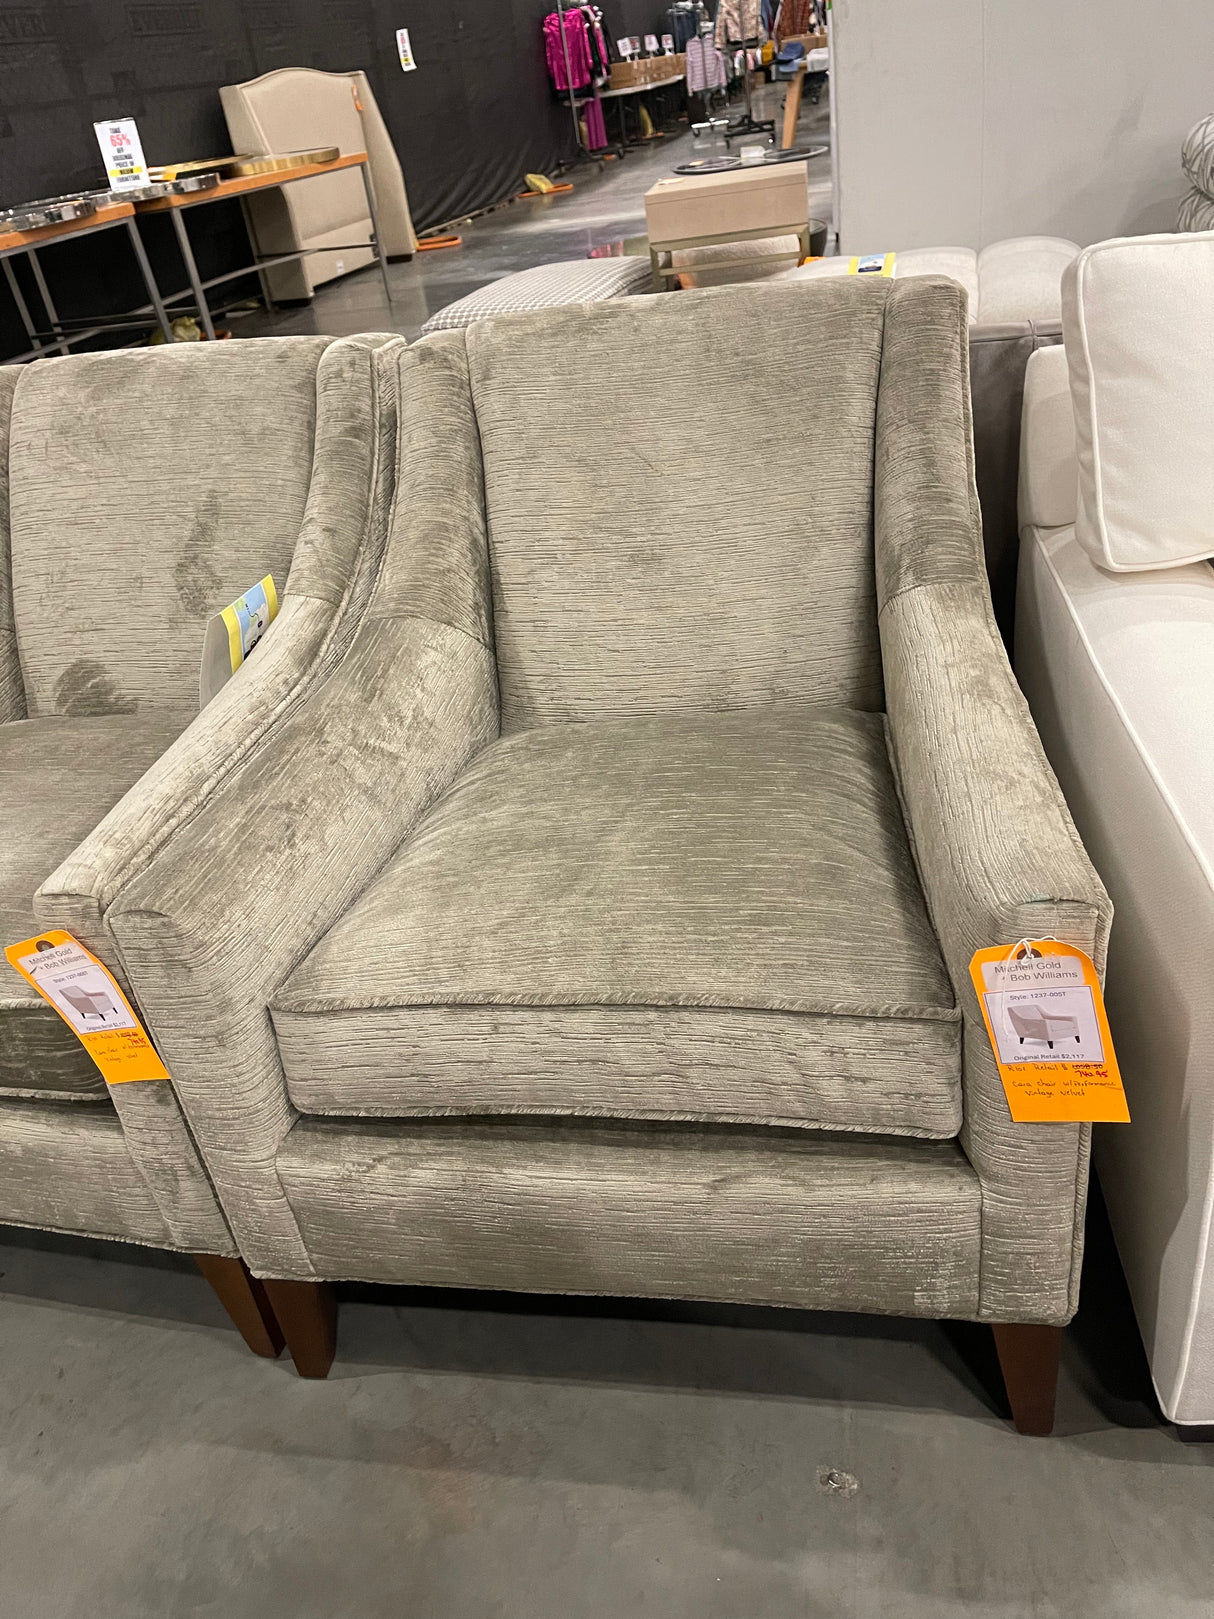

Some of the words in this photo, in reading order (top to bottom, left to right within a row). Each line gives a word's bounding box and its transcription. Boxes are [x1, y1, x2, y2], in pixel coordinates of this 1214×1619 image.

[110, 133, 131, 147] 65%
[55, 948, 72, 957] Gold
[44, 960, 59, 970] Bob
[58, 954, 87, 966] Williams
[1036, 962, 1062, 970] Gold
[1010, 973, 1031, 982] Bob
[1033, 971, 1079, 980] Williams
